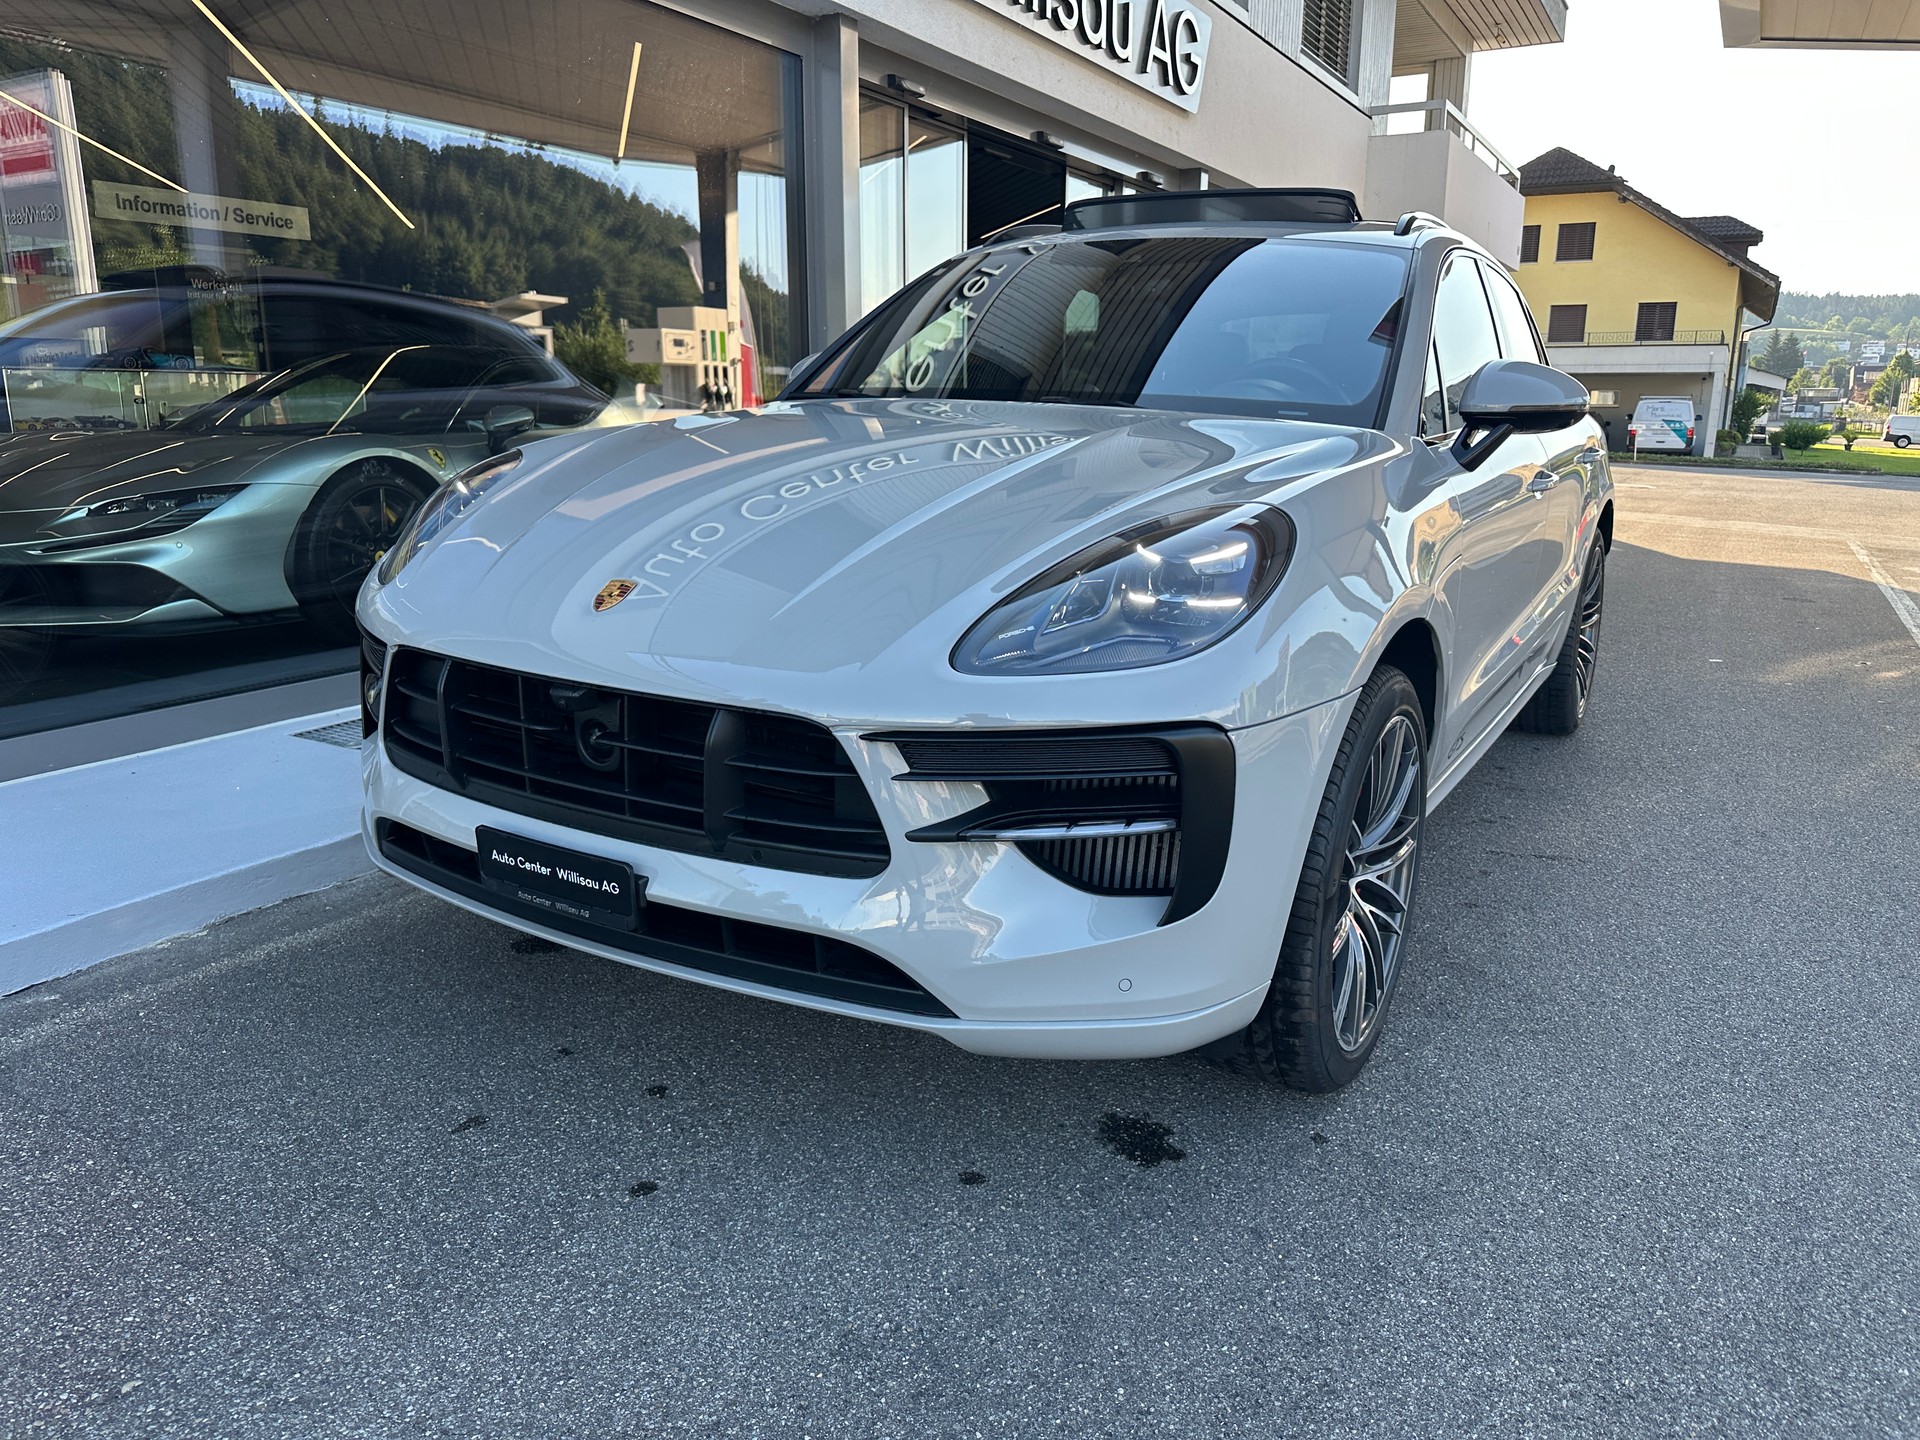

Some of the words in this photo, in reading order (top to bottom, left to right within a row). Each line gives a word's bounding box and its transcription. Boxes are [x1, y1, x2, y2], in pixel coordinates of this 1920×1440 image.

[1147, 0, 1203, 95] AG
[115, 193, 220, 221] Information
[224, 206, 229, 222] /
[233, 207, 294, 230] Service
[191, 278, 243, 292] Werkstatt
[998, 625, 1035, 640] PORSCHE
[491, 849, 516, 866] Auto
[517, 856, 552, 876] Center
[556, 867, 600, 890] Willisau
[601, 880, 620, 894] AG
[517, 891, 532, 901] Auto
[532, 895, 552, 907] Center
[580, 909, 590, 918] AG
